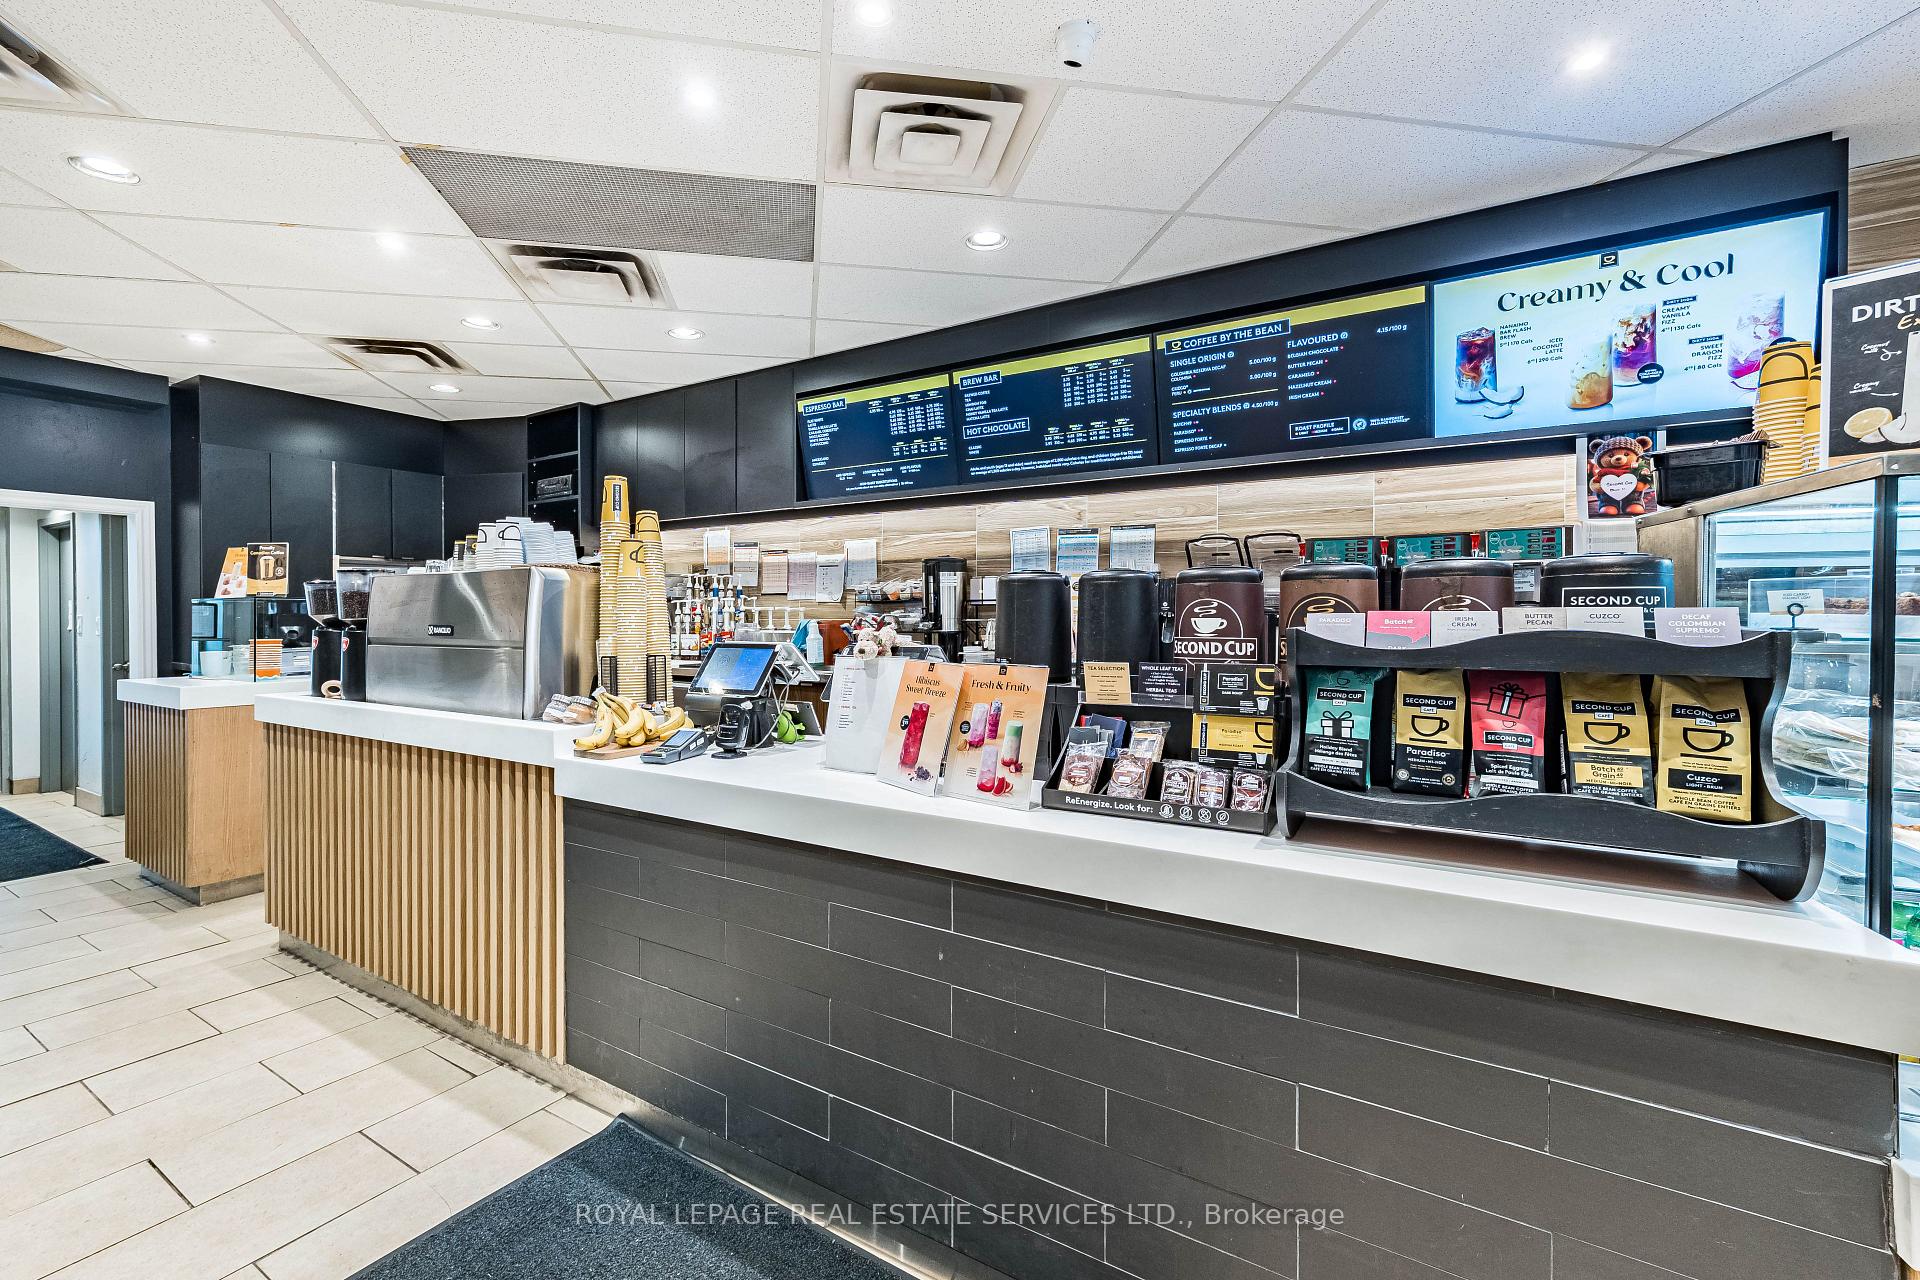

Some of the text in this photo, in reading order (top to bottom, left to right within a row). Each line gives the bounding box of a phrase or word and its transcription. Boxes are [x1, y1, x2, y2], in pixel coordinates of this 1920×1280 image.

[1497, 253, 1734, 312] Creamy & Cool
[1662, 305, 1690, 313] CREAMY
[1662, 311, 1690, 319] VANILLA
[1183, 323, 1282, 349] COFFEE BY THE BEAN
[1287, 333, 1339, 349] FLAVOURED
[1308, 346, 1339, 356] CHOCOLATE
[1532, 343, 1563, 351] COCONUT
[1700, 343, 1723, 351] SWEET
[1691, 349, 1723, 358] DRAGON
[1170, 352, 1226, 368] SINGLE ORIGIN
[962, 374, 999, 387] BREW BAR
[805, 401, 845, 413] ESPRESSO BAR
[1172, 403, 1242, 419] SPECIALTY BLENDS
[966, 421, 1026, 436] HOT CHOCOLATE
[1313, 422, 1335, 430] PROFILE
[1570, 595, 1661, 606] SECOND CUP
[1174, 640, 1255, 656] SECOND CUP
[915, 675, 941, 687] Hibiscus
[971, 678, 1032, 695] Fresh & Fruity
[905, 683, 947, 698] Sweet Breeze
[1319, 691, 1348, 699] SECOND
[1405, 697, 1437, 705] SECOND
[1675, 708, 1736, 720] SECOND CUP
[1487, 734, 1517, 742] SECOND
[1319, 744, 1338, 752] Holiday
[1406, 746, 1446, 758] Paradiso
[1509, 765, 1529, 773] Eggnog
[1590, 764, 1616, 773] Batch
[1592, 770, 1616, 779] Grain
[1686, 773, 1718, 783] Cuzco
[1065, 796, 1154, 813] ReEnergize. Look for:
